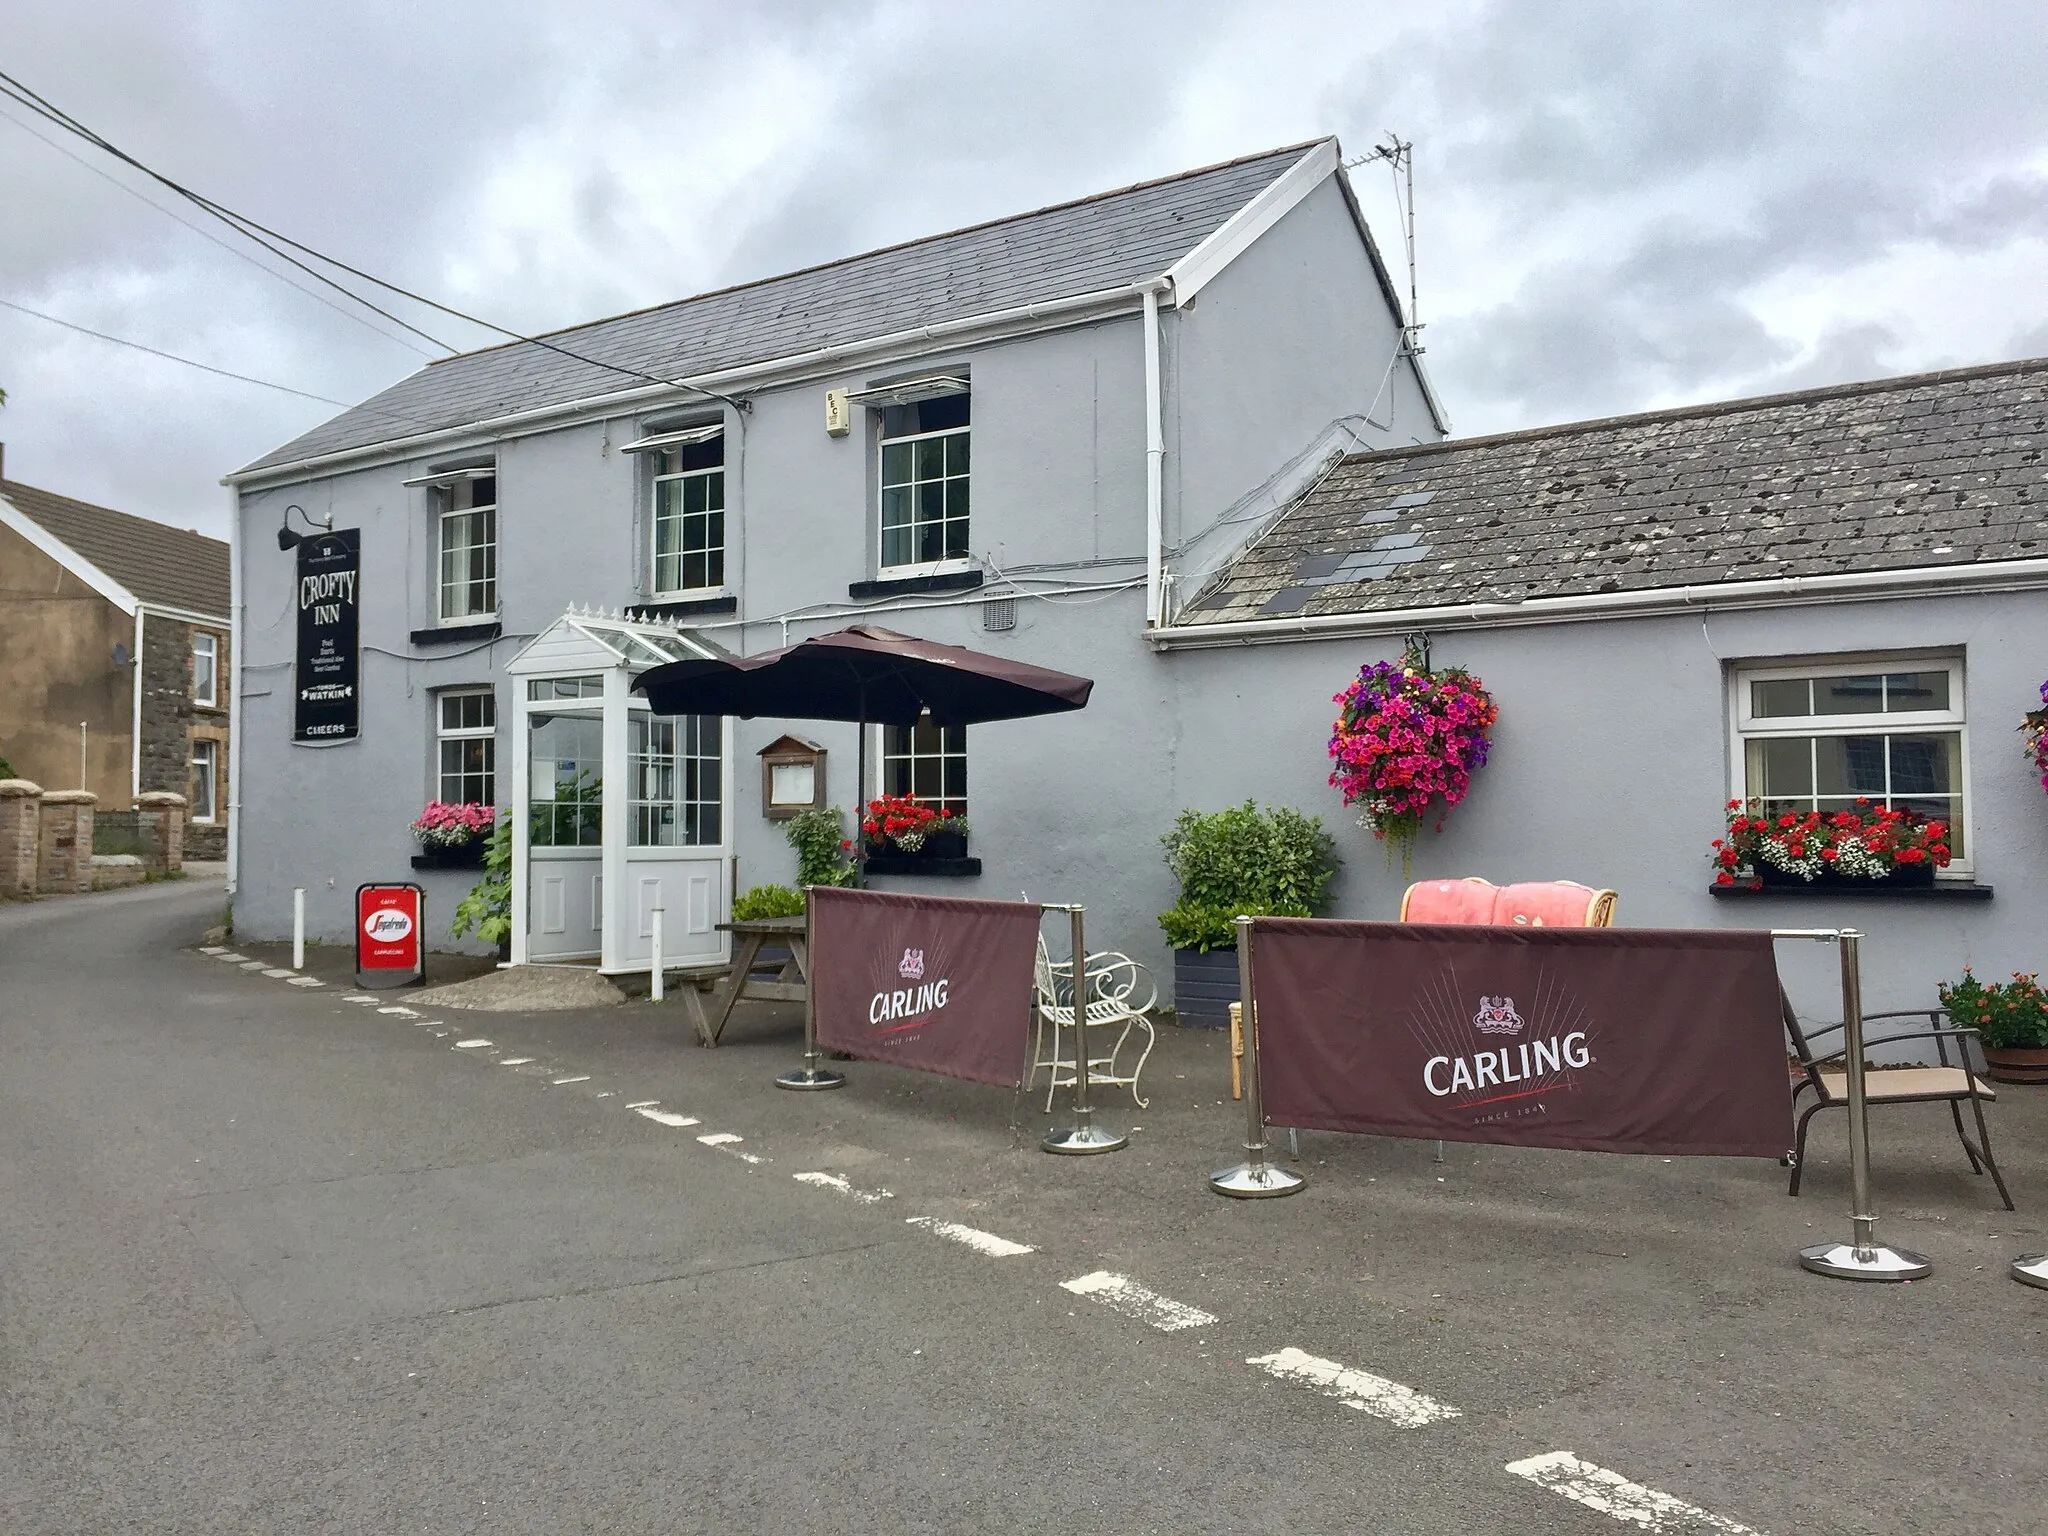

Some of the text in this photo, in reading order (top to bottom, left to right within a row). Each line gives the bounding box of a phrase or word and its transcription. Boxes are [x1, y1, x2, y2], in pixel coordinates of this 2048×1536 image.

[301, 570, 356, 610] CROFTY
[314, 603, 340, 625] INN
[309, 689, 344, 701] WATKIN
[869, 979, 949, 1025] CARLING
[1423, 1031, 1591, 1097] CARLING
[1474, 1110, 1510, 1125] SINCE
